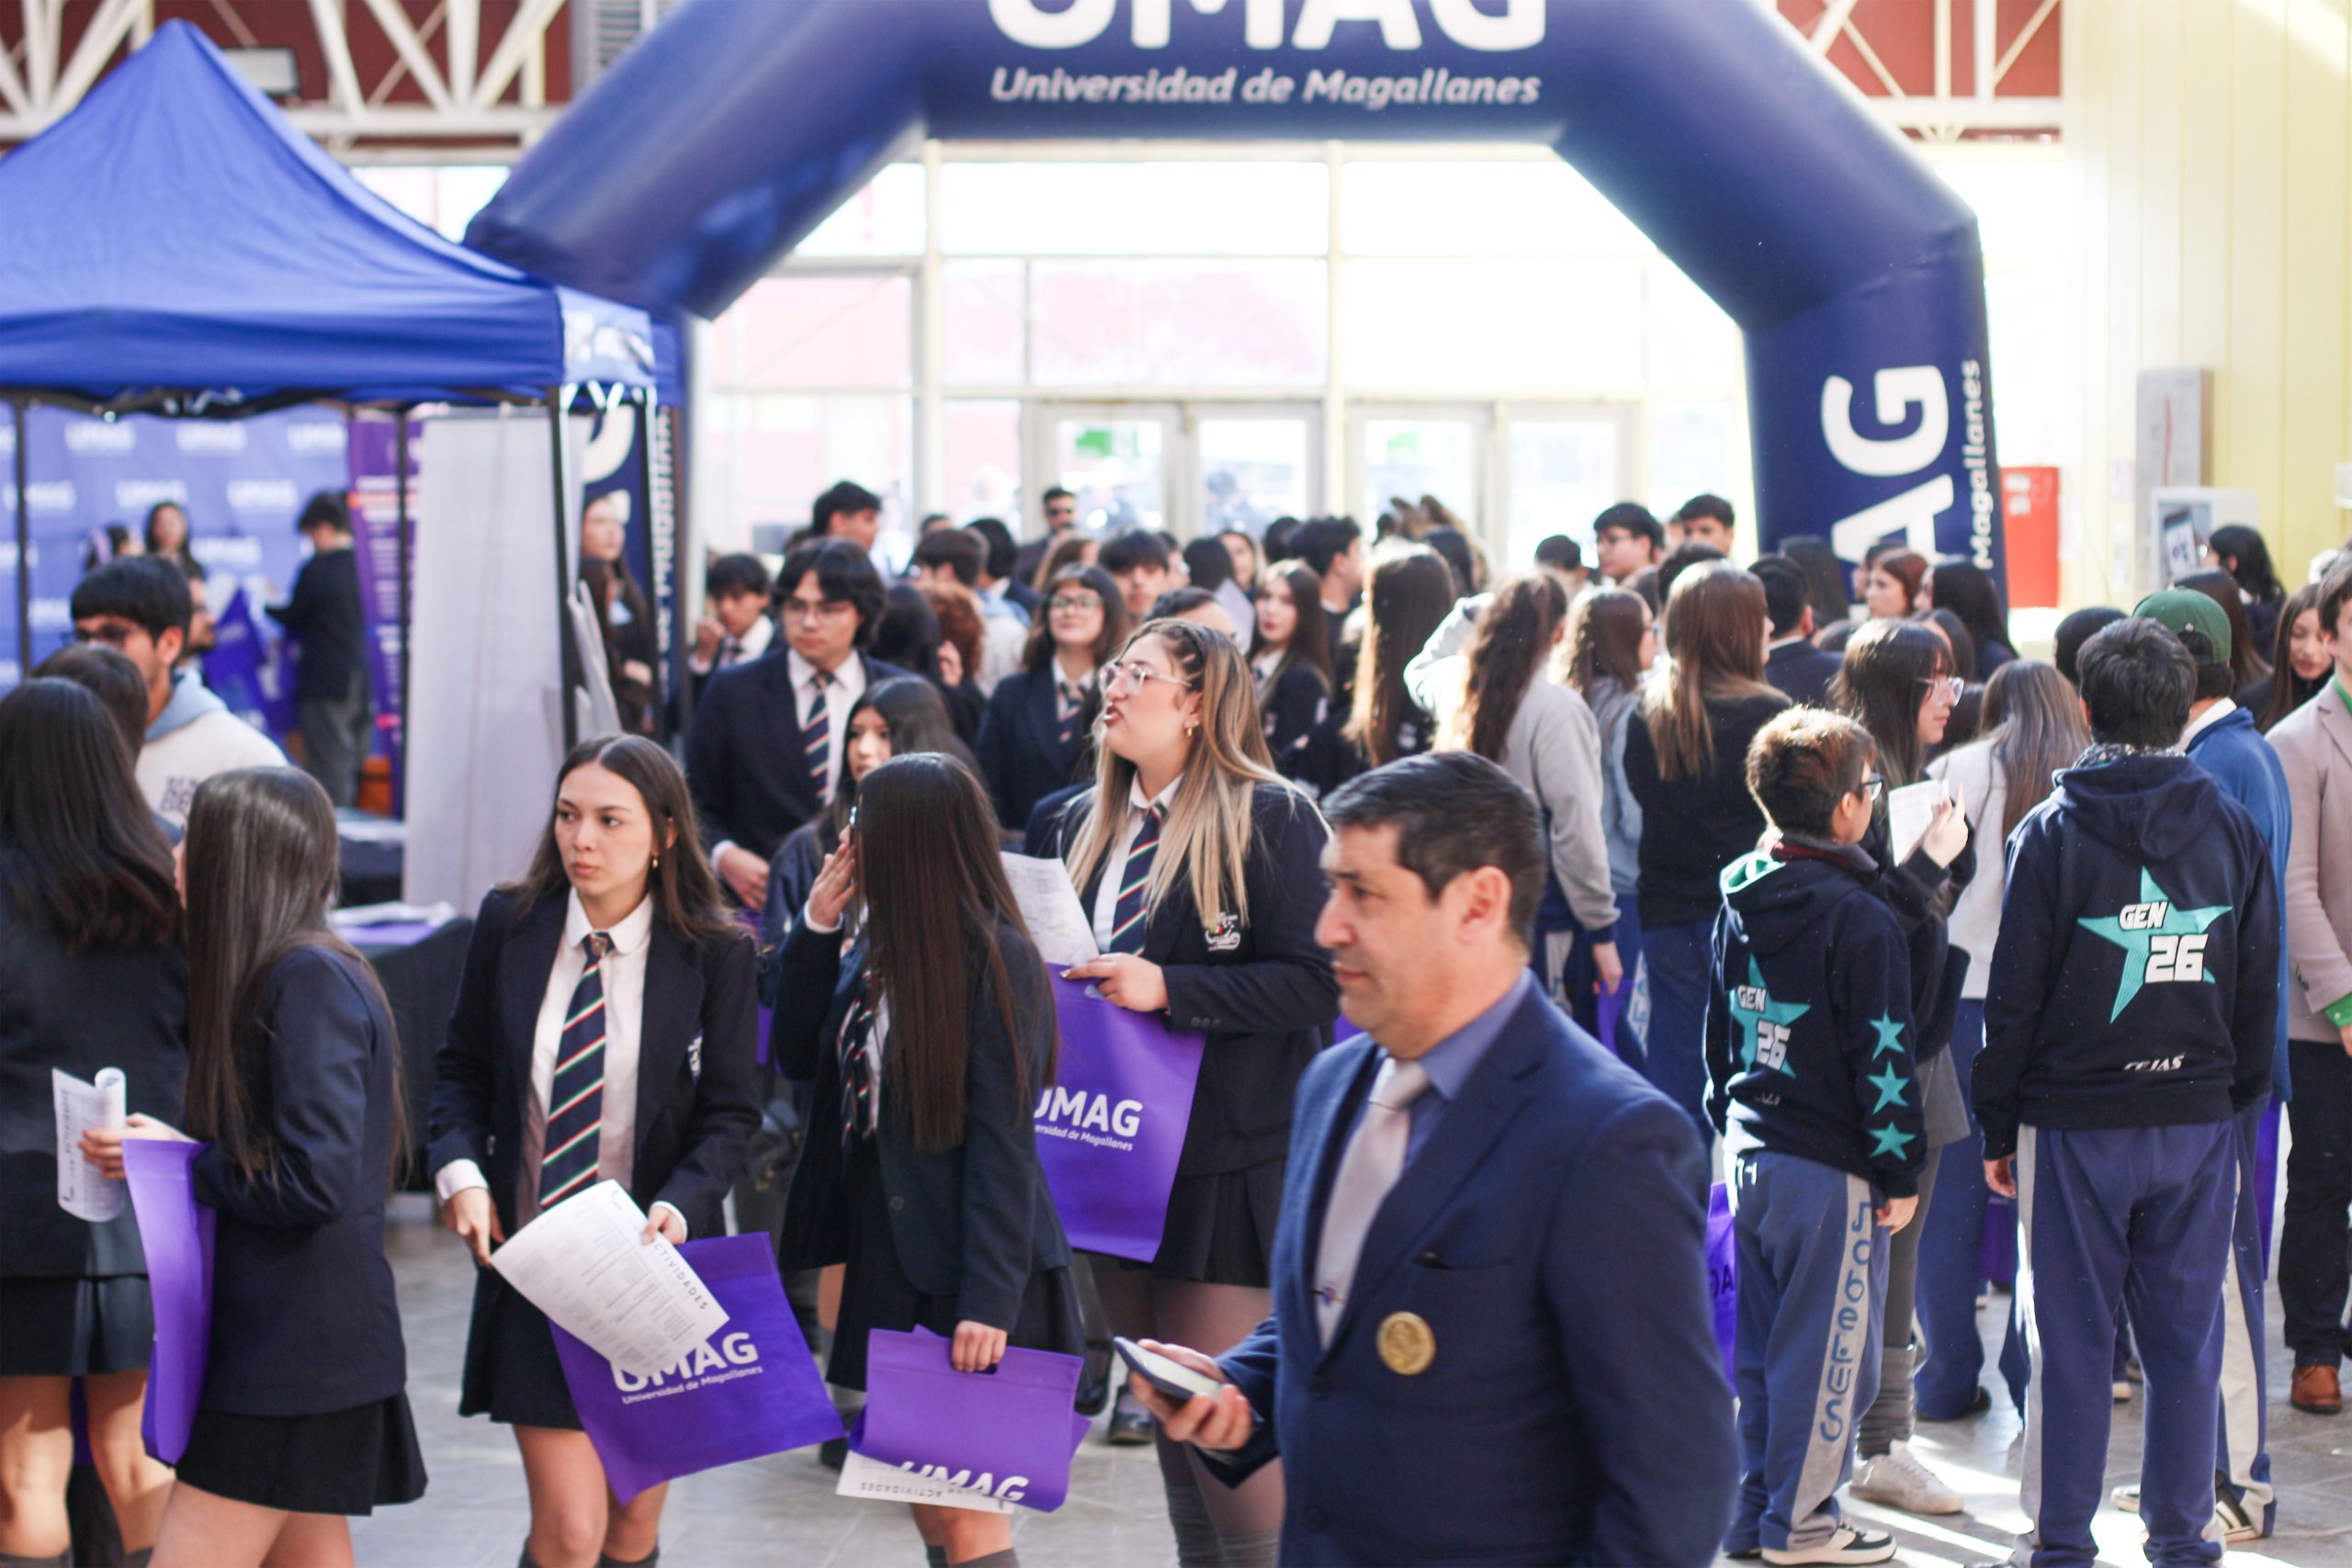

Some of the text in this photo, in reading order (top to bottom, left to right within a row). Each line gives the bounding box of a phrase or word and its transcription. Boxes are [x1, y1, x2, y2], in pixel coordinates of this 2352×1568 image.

[990, 67, 1541, 110] Universidad de Magallanes
[2120, 901, 2167, 930] GEN
[2144, 933, 2209, 984] 26
[1737, 985, 1767, 1012] GEN
[1757, 1019, 1792, 1071] 26
[1068, 1129, 1080, 1141] de
[1080, 1132, 1133, 1152] Magallanes
[622, 1366, 763, 1404] Universidad de Magallanes
[860, 1482, 943, 1498] ACTIVIDADES
